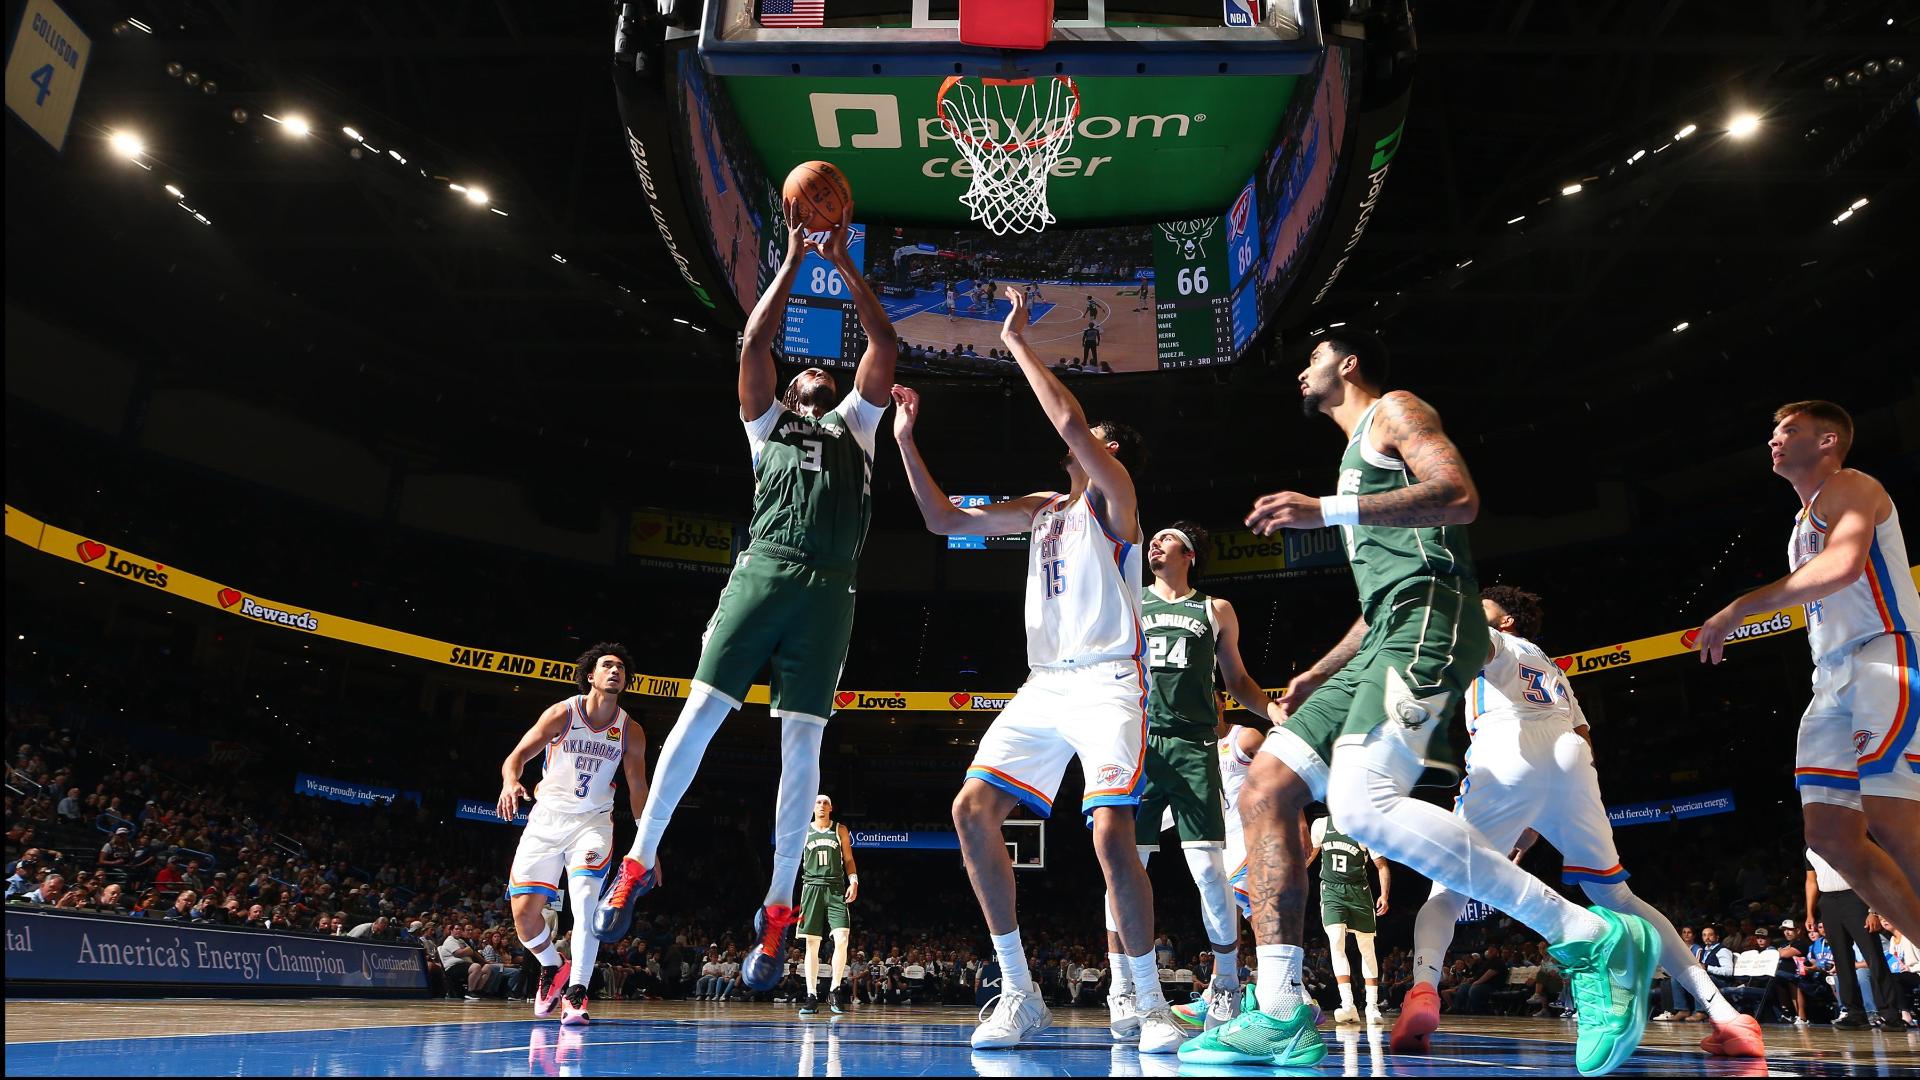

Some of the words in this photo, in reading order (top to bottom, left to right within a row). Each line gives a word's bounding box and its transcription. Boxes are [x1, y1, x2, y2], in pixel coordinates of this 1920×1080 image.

[1230, 13, 1247, 24] NBA
[32, 12, 79, 70] COLLISON
[30, 63, 55, 107] 4
[626, 126, 657, 200] center
[1344, 163, 1390, 252] paycom
[649, 204, 701, 286] paycom
[1238, 235, 1252, 276] 86
[810, 266, 842, 296] 86
[1177, 266, 1209, 296] 66
[788, 297, 807, 305] PLAYER
[784, 345, 809, 354] WILLIAMS
[1158, 341, 1180, 349] ROLLINS
[822, 358, 836, 366] 3RD
[1198, 357, 1211, 365] 3RD
[800, 439, 823, 472] 3
[969, 497, 985, 507] 86
[677, 562, 698, 572] THE
[1256, 569, 1308, 581] THUNDER
[1042, 560, 1067, 600] 15
[241, 596, 319, 631] Rewards
[1723, 612, 1791, 643] ewards
[449, 646, 493, 670] SAVE
[500, 655, 536, 676] AND
[1149, 636, 1188, 669] 24
[648, 678, 680, 697] TURN
[563, 739, 622, 762] OKLAHOMA
[575, 755, 602, 773] CITY
[306, 779, 318, 790] We
[319, 784, 329, 792] are
[330, 786, 357, 799] proudly
[574, 773, 593, 799] 3
[461, 804, 477, 813] And
[1608, 811, 1625, 821] And
[1626, 808, 1653, 820] fiercely
[856, 832, 909, 843] Continental
[817, 850, 828, 866] 11
[1331, 853, 1348, 873] 13
[78, 932, 190, 969] America's
[197, 941, 261, 980] Energy
[266, 945, 345, 977] Champion
[370, 952, 420, 972] Continental
